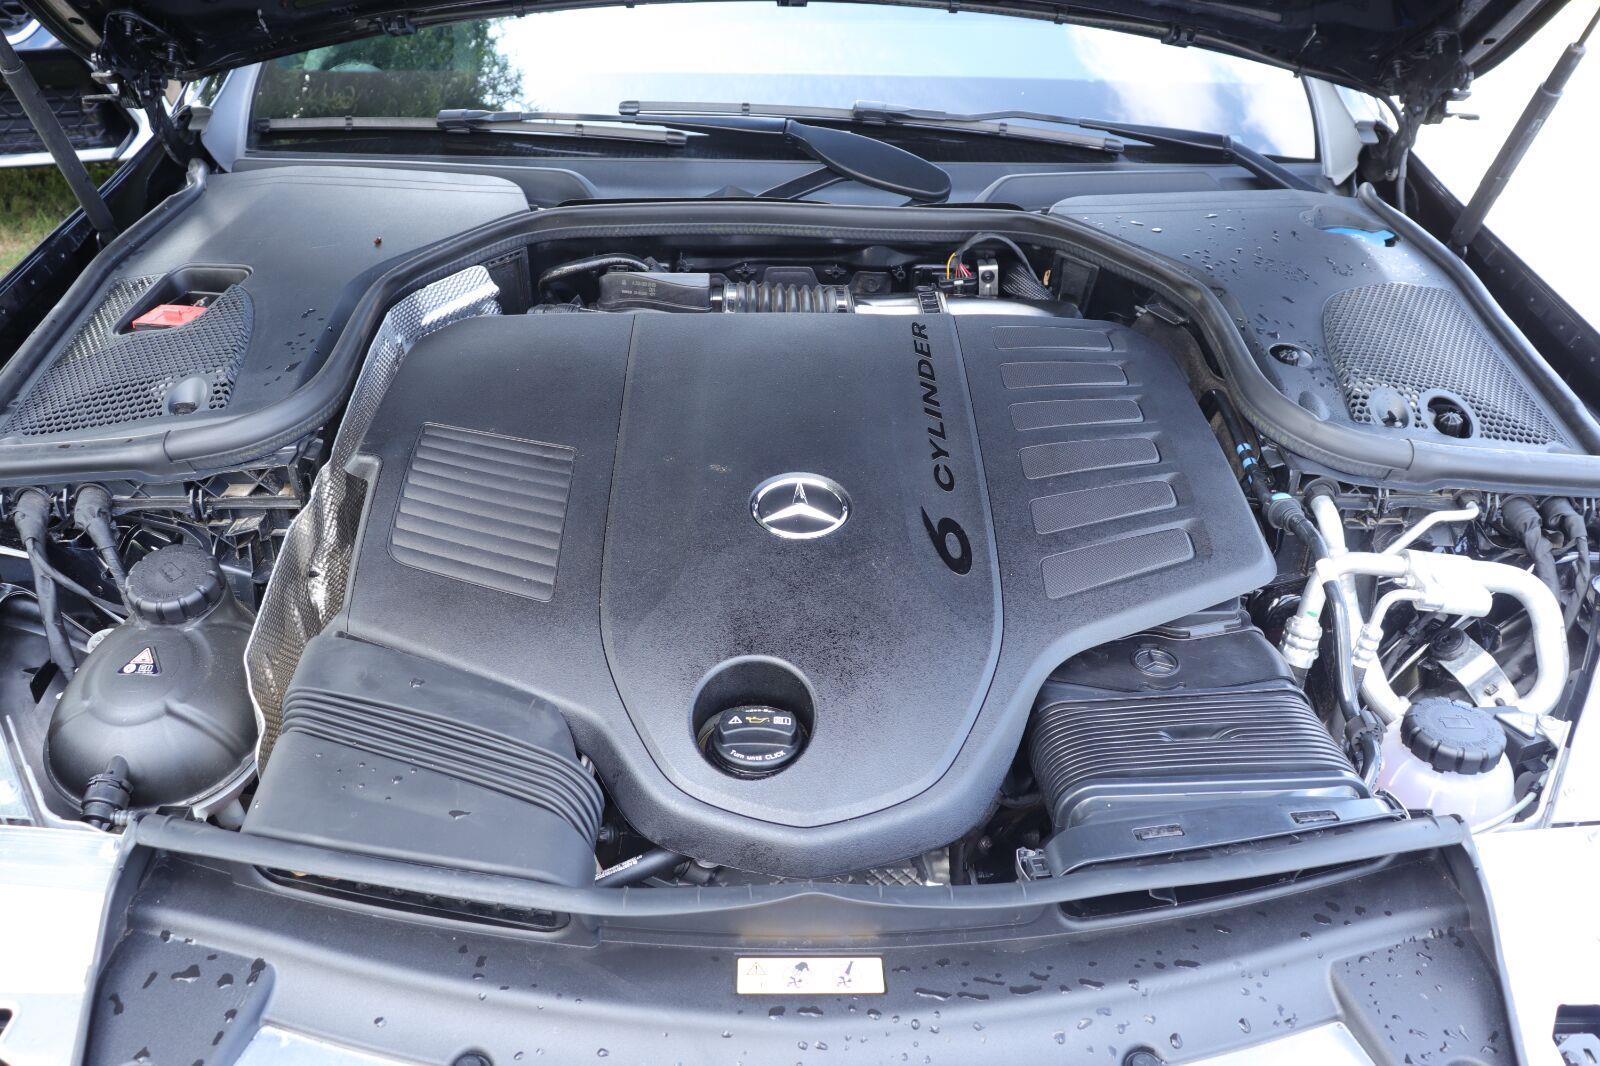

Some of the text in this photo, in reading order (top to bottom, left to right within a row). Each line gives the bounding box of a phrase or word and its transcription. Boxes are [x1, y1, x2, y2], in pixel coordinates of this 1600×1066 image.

[911, 321, 973, 575] 6 CYLINDER
[730, 749, 745, 759] Turn
[765, 750, 786, 760] CLICK
